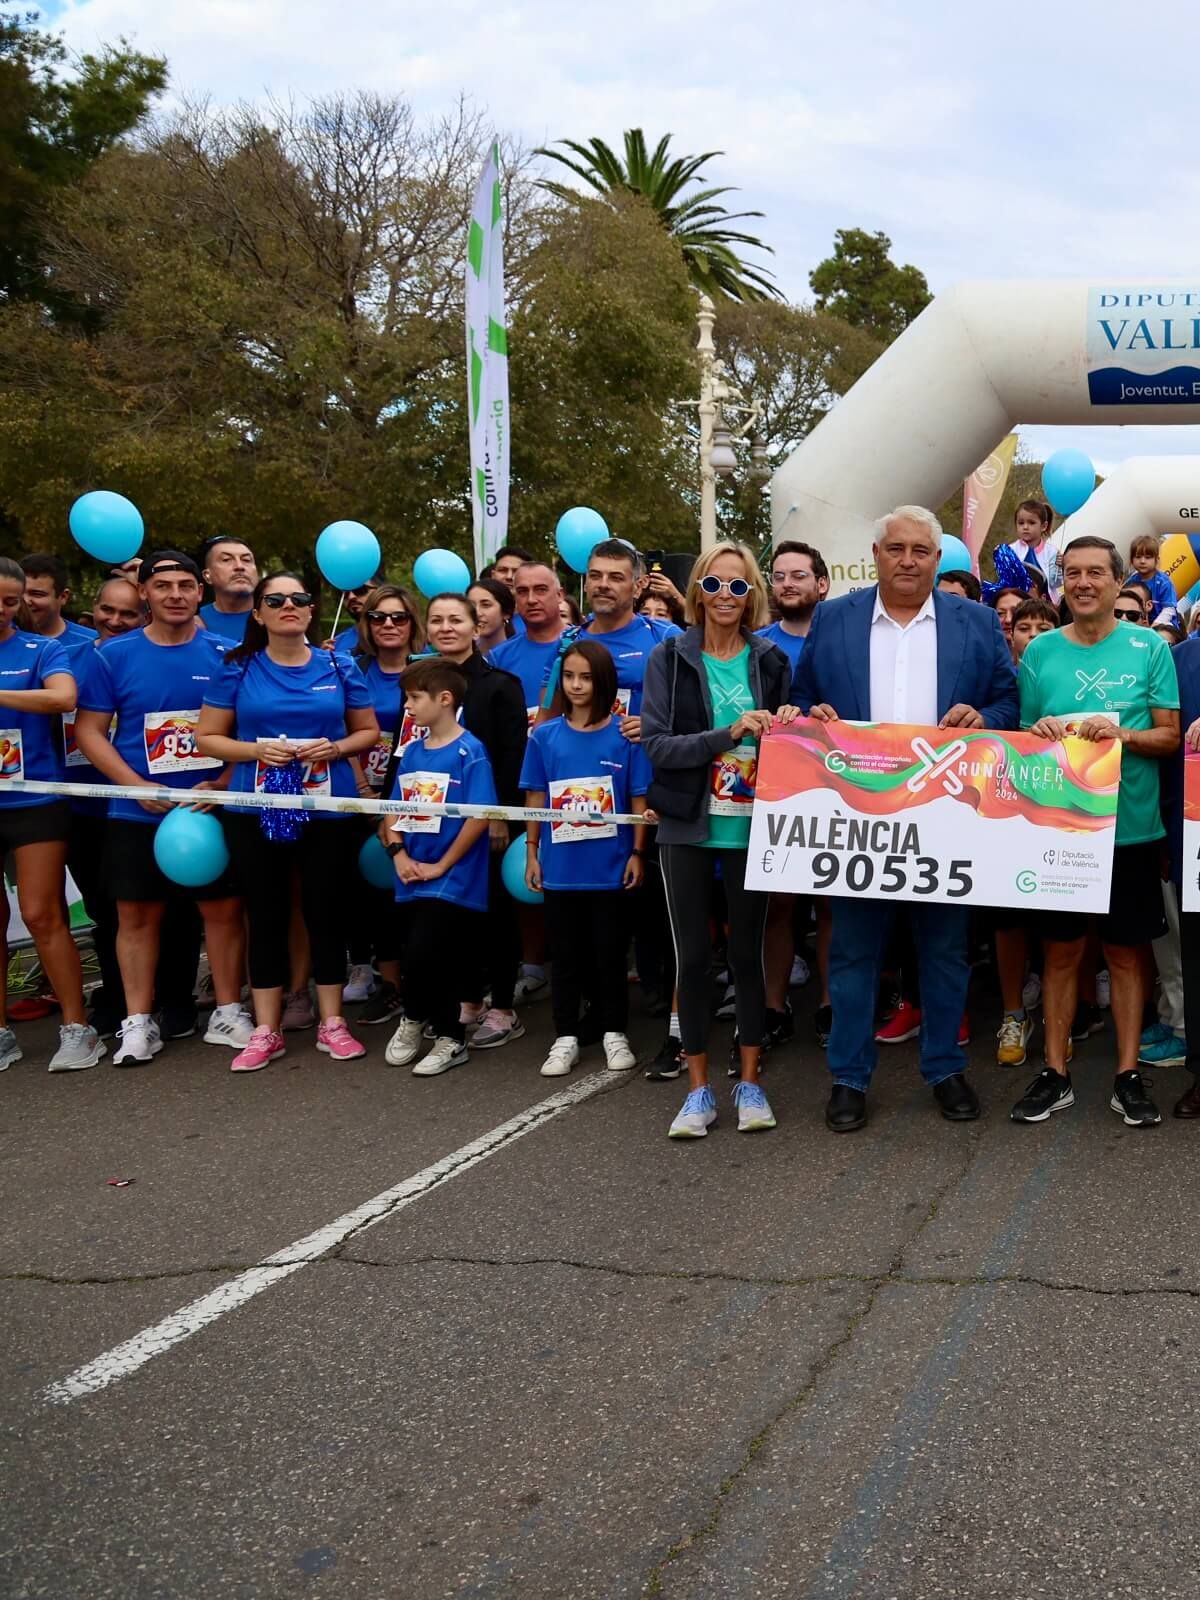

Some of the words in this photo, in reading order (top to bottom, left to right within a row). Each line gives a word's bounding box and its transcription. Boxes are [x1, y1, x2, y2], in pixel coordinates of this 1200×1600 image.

[1120, 382, 1189, 399] Joventut,
[831, 558, 879, 581] ncia
[411, 724, 431, 741] 92
[164, 733, 199, 755] 93
[368, 751, 390, 772] 92
[719, 771, 737, 797] 2
[995, 789, 1018, 801] 2024
[766, 810, 921, 856] VALÈNCIA
[1062, 850, 1094, 860] Diputació
[1072, 860, 1099, 869] València
[811, 852, 974, 898] 90535
